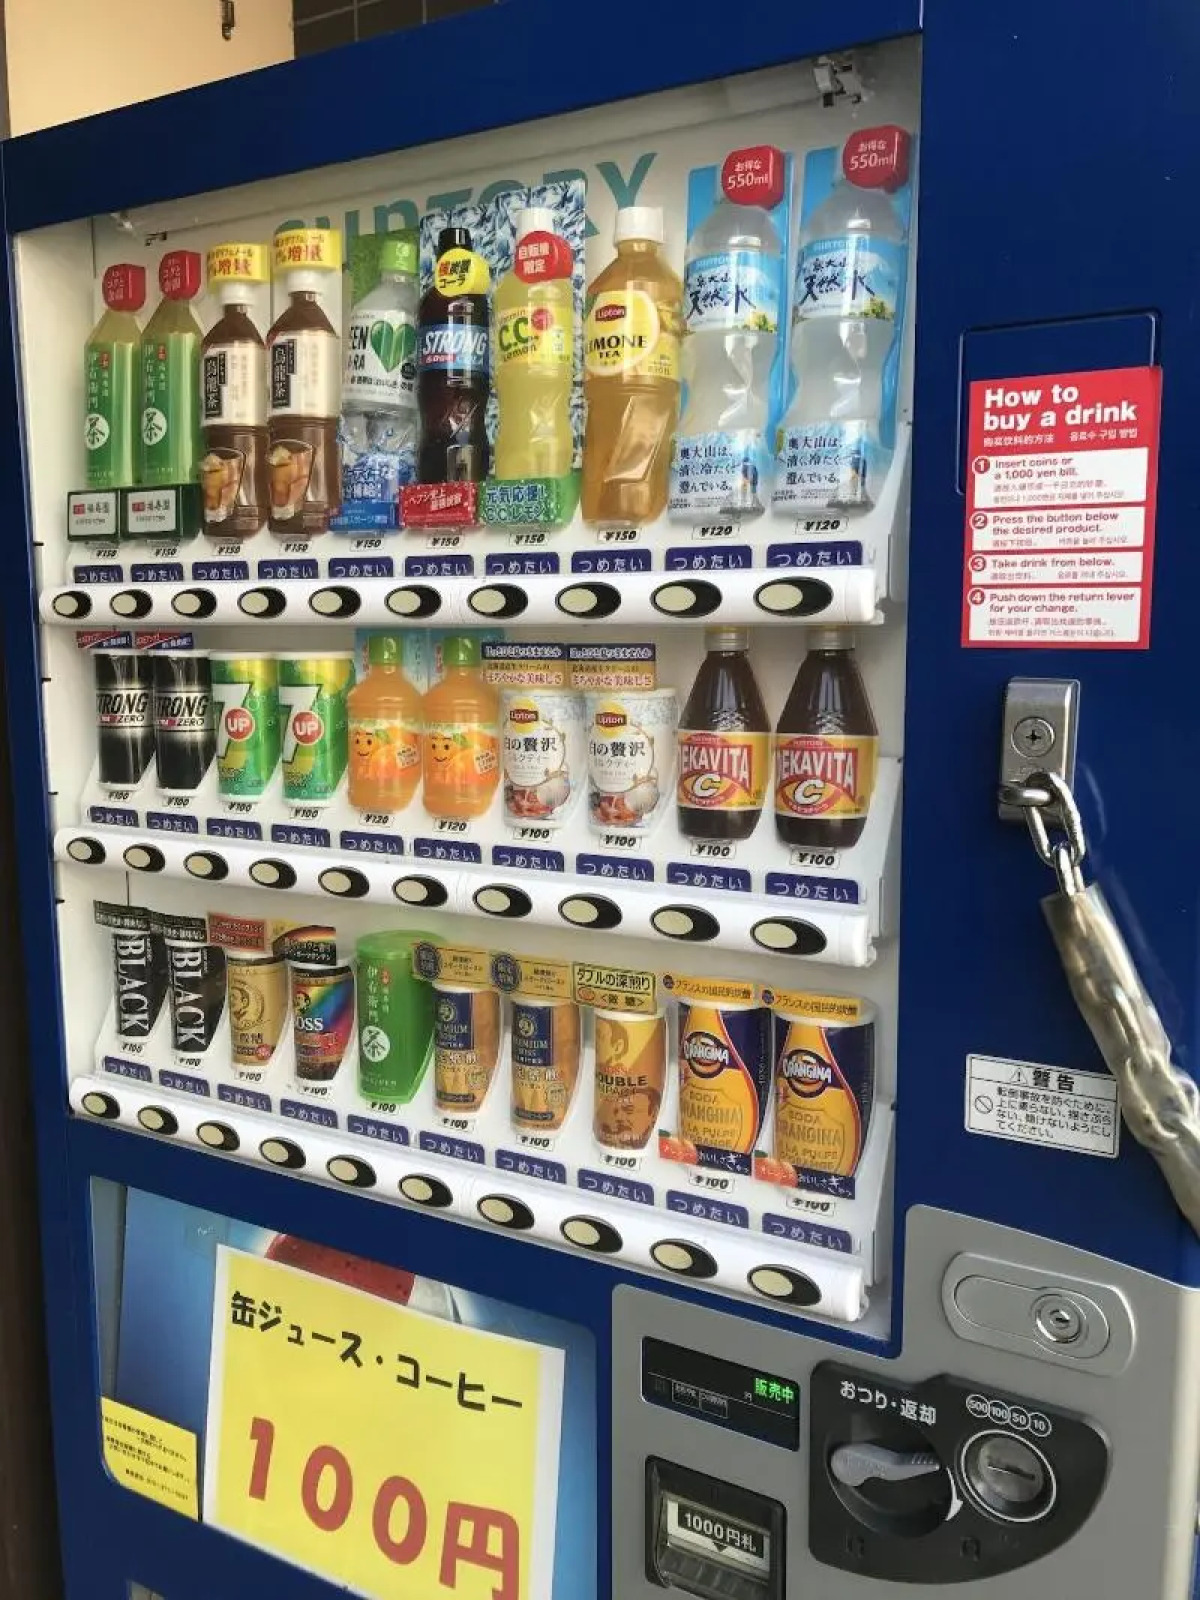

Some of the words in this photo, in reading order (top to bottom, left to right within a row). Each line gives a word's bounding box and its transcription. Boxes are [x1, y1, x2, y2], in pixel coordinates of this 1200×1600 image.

[850, 153, 895, 171] 550ml
[727, 173, 769, 190] 550ml
[438, 277, 466, 289] コーラ
[423, 330, 488, 355] STRONG
[599, 350, 621, 359] TEA
[984, 387, 1042, 409] How
[1051, 383, 1080, 404] to
[983, 410, 1032, 432] buy
[1040, 411, 1057, 428] a
[1064, 400, 1138, 426] drink
[979, 459, 986, 472] 1
[994, 458, 1028, 469] Insert
[1028, 457, 1059, 468] coins
[1061, 457, 1075, 467] or
[993, 472, 1001, 481] a
[1004, 470, 1033, 481] 1,000
[1037, 469, 1057, 480] yen
[1058, 467, 1080, 477] bill.
[804, 519, 841, 531] ¥120
[974, 514, 986, 528] 2
[992, 515, 1024, 525] Press
[1026, 514, 1044, 524] the
[1046, 513, 1083, 523] button
[1085, 511, 1121, 521] below
[603, 530, 637, 541] ¥150
[700, 525, 733, 537] ¥120
[992, 525, 1009, 536] the
[1011, 524, 1053, 535] desired
[1055, 523, 1103, 535] product.
[354, 539, 382, 548] ¥150
[431, 536, 460, 547] ¥150
[514, 533, 545, 544] ¥150
[154, 547, 178, 557] ¥150
[217, 546, 241, 555] ¥150
[284, 543, 309, 553] ¥150
[578, 557, 644, 573] つめたい
[672, 554, 744, 571] つめたい
[772, 550, 851, 567] つめたい
[973, 557, 983, 571] 3
[991, 558, 1018, 569] Take
[1019, 558, 1048, 569] drink
[1050, 557, 1076, 568] from
[1078, 556, 1116, 568] below.
[197, 568, 245, 580] つめたい
[262, 566, 313, 578] つめたい
[334, 565, 388, 577] つめたい
[410, 562, 468, 576] つめたい
[491, 560, 552, 574] つめたい
[77, 570, 119, 583] つめたい
[135, 569, 178, 582] つめたい
[972, 590, 983, 603] 4
[989, 593, 1017, 603] Push
[1018, 593, 1047, 603] down
[1049, 592, 1066, 602] the
[1068, 592, 1104, 602] return
[1106, 592, 1135, 602] lever
[989, 603, 1006, 613] for
[1007, 604, 1032, 614] your
[1035, 603, 1078, 614] change.
[117, 714, 145, 723] ZERO
[177, 718, 205, 727] ZERO
[212, 683, 253, 758] 7
[510, 710, 537, 720] Lipton
[227, 717, 249, 733] UP
[278, 684, 321, 763] 7
[294, 721, 318, 736] UP
[107, 792, 130, 801] ¥100
[167, 797, 190, 807] ¥100
[228, 802, 252, 812] ¥100
[293, 808, 319, 819] ¥100
[95, 812, 135, 826] つめたい
[151, 818, 194, 832] つめたい
[363, 813, 390, 825] ¥120
[438, 820, 467, 832] ¥120
[211, 825, 257, 839] つめたい
[275, 831, 326, 845] つめたい
[521, 827, 550, 839] ¥100
[346, 838, 397, 853] つめたい
[604, 834, 637, 848] ¥100
[419, 845, 476, 862] つめたい
[696, 844, 731, 857] ¥100
[500, 853, 558, 870] つめたい
[799, 852, 835, 867] ¥100
[582, 862, 647, 881] つめたい
[674, 871, 745, 891] つめたい
[773, 880, 850, 901] つめたい
[116, 937, 150, 1033] BLACK
[172, 950, 207, 1046] BLACK
[364, 1028, 386, 1057] 茶
[108, 1061, 148, 1079] つめたい
[238, 1072, 262, 1082] ¥100
[163, 1076, 206, 1095] つめたい
[1032, 1067, 1075, 1093] 警告
[303, 1086, 329, 1096] ¥100
[222, 1091, 269, 1111] つめたい
[371, 1101, 397, 1114] ¥100
[286, 1106, 336, 1128] つめたい
[442, 1117, 469, 1130] ¥100
[353, 1121, 405, 1145] つめたい
[996, 1120, 1054, 1139] てください。
[521, 1135, 550, 1148] ¥100
[424, 1138, 481, 1162] つめたい
[603, 1153, 637, 1168] ¥100
[501, 1156, 561, 1182] つめたい
[693, 1173, 730, 1190] ¥100
[584, 1176, 648, 1203] つめたい
[791, 1196, 831, 1213] ¥100
[673, 1198, 743, 1227] つめたい
[771, 1222, 844, 1251] つめたい
[229, 1291, 523, 1412] 缶ジュース・コーヒー
[755, 1377, 795, 1404] 販売中
[840, 1379, 937, 1426] おつり・返却
[969, 1399, 988, 1413] 500
[990, 1404, 1008, 1420] 100
[1012, 1412, 1026, 1425] 50
[1034, 1418, 1045, 1431] 10
[248, 1416, 520, 1600] 100円
[684, 1511, 757, 1552] 1000円札
